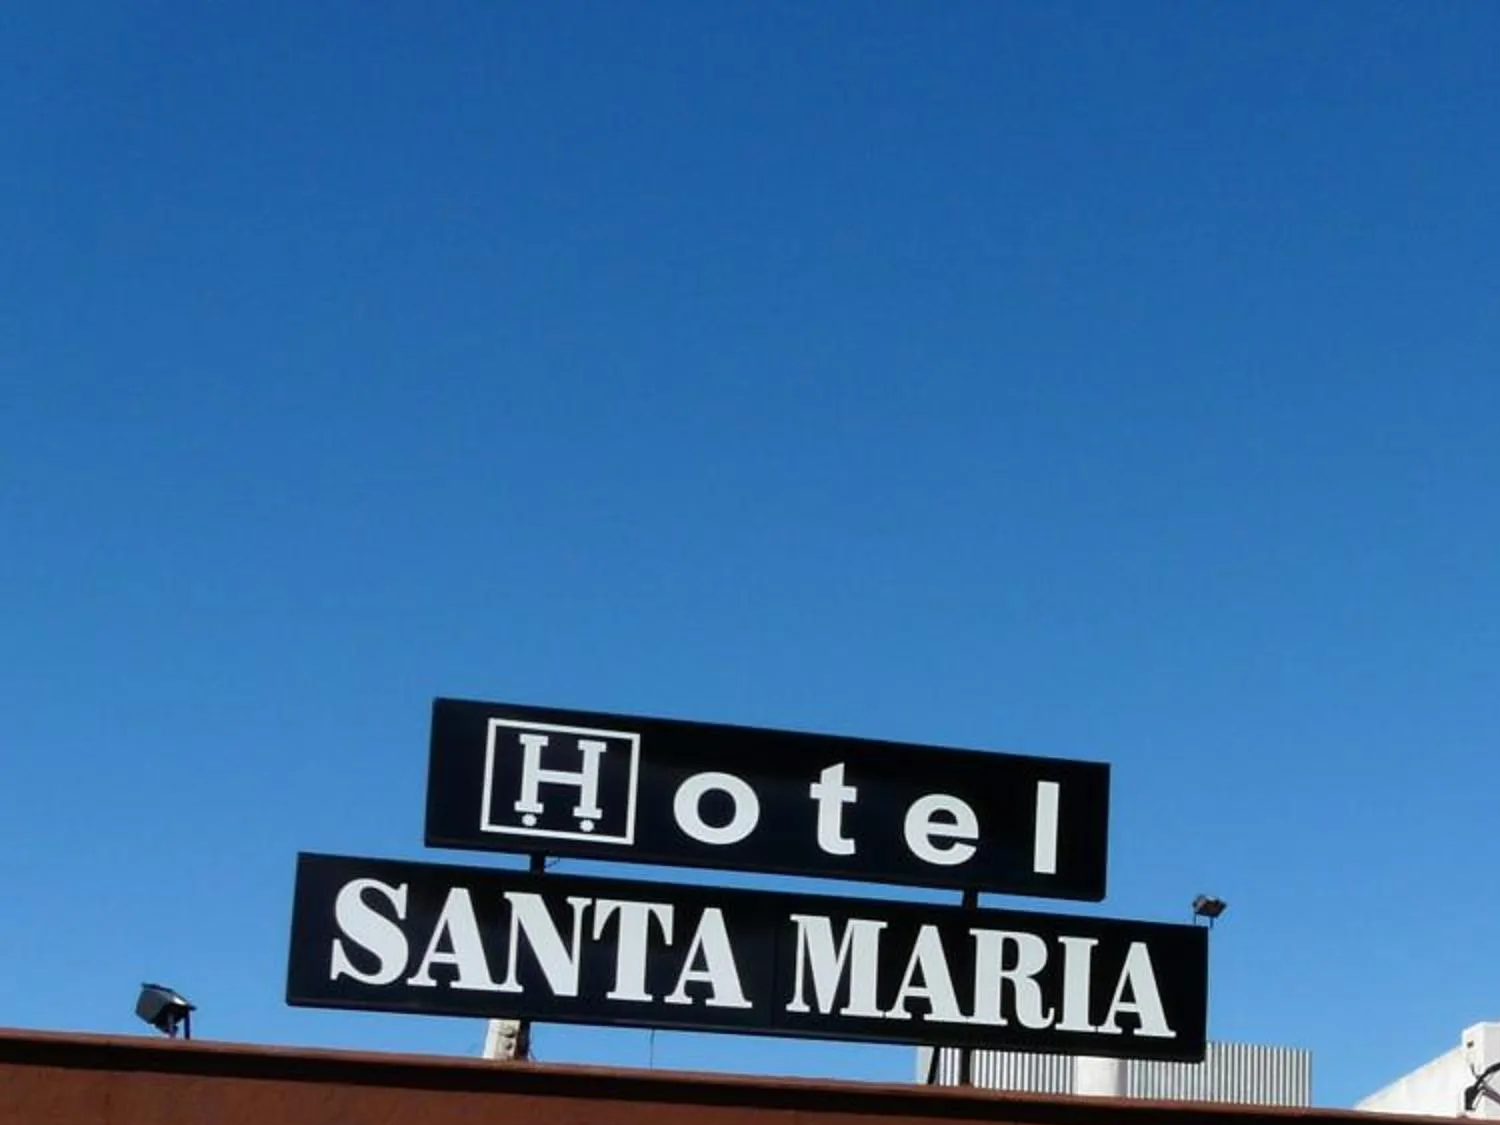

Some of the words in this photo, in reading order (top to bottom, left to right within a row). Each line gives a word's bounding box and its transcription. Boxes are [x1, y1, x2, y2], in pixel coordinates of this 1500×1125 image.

[514, 733, 1060, 874] Hotel
[330, 878, 753, 1009] SANTA
[785, 914, 1177, 1038] MARIA
